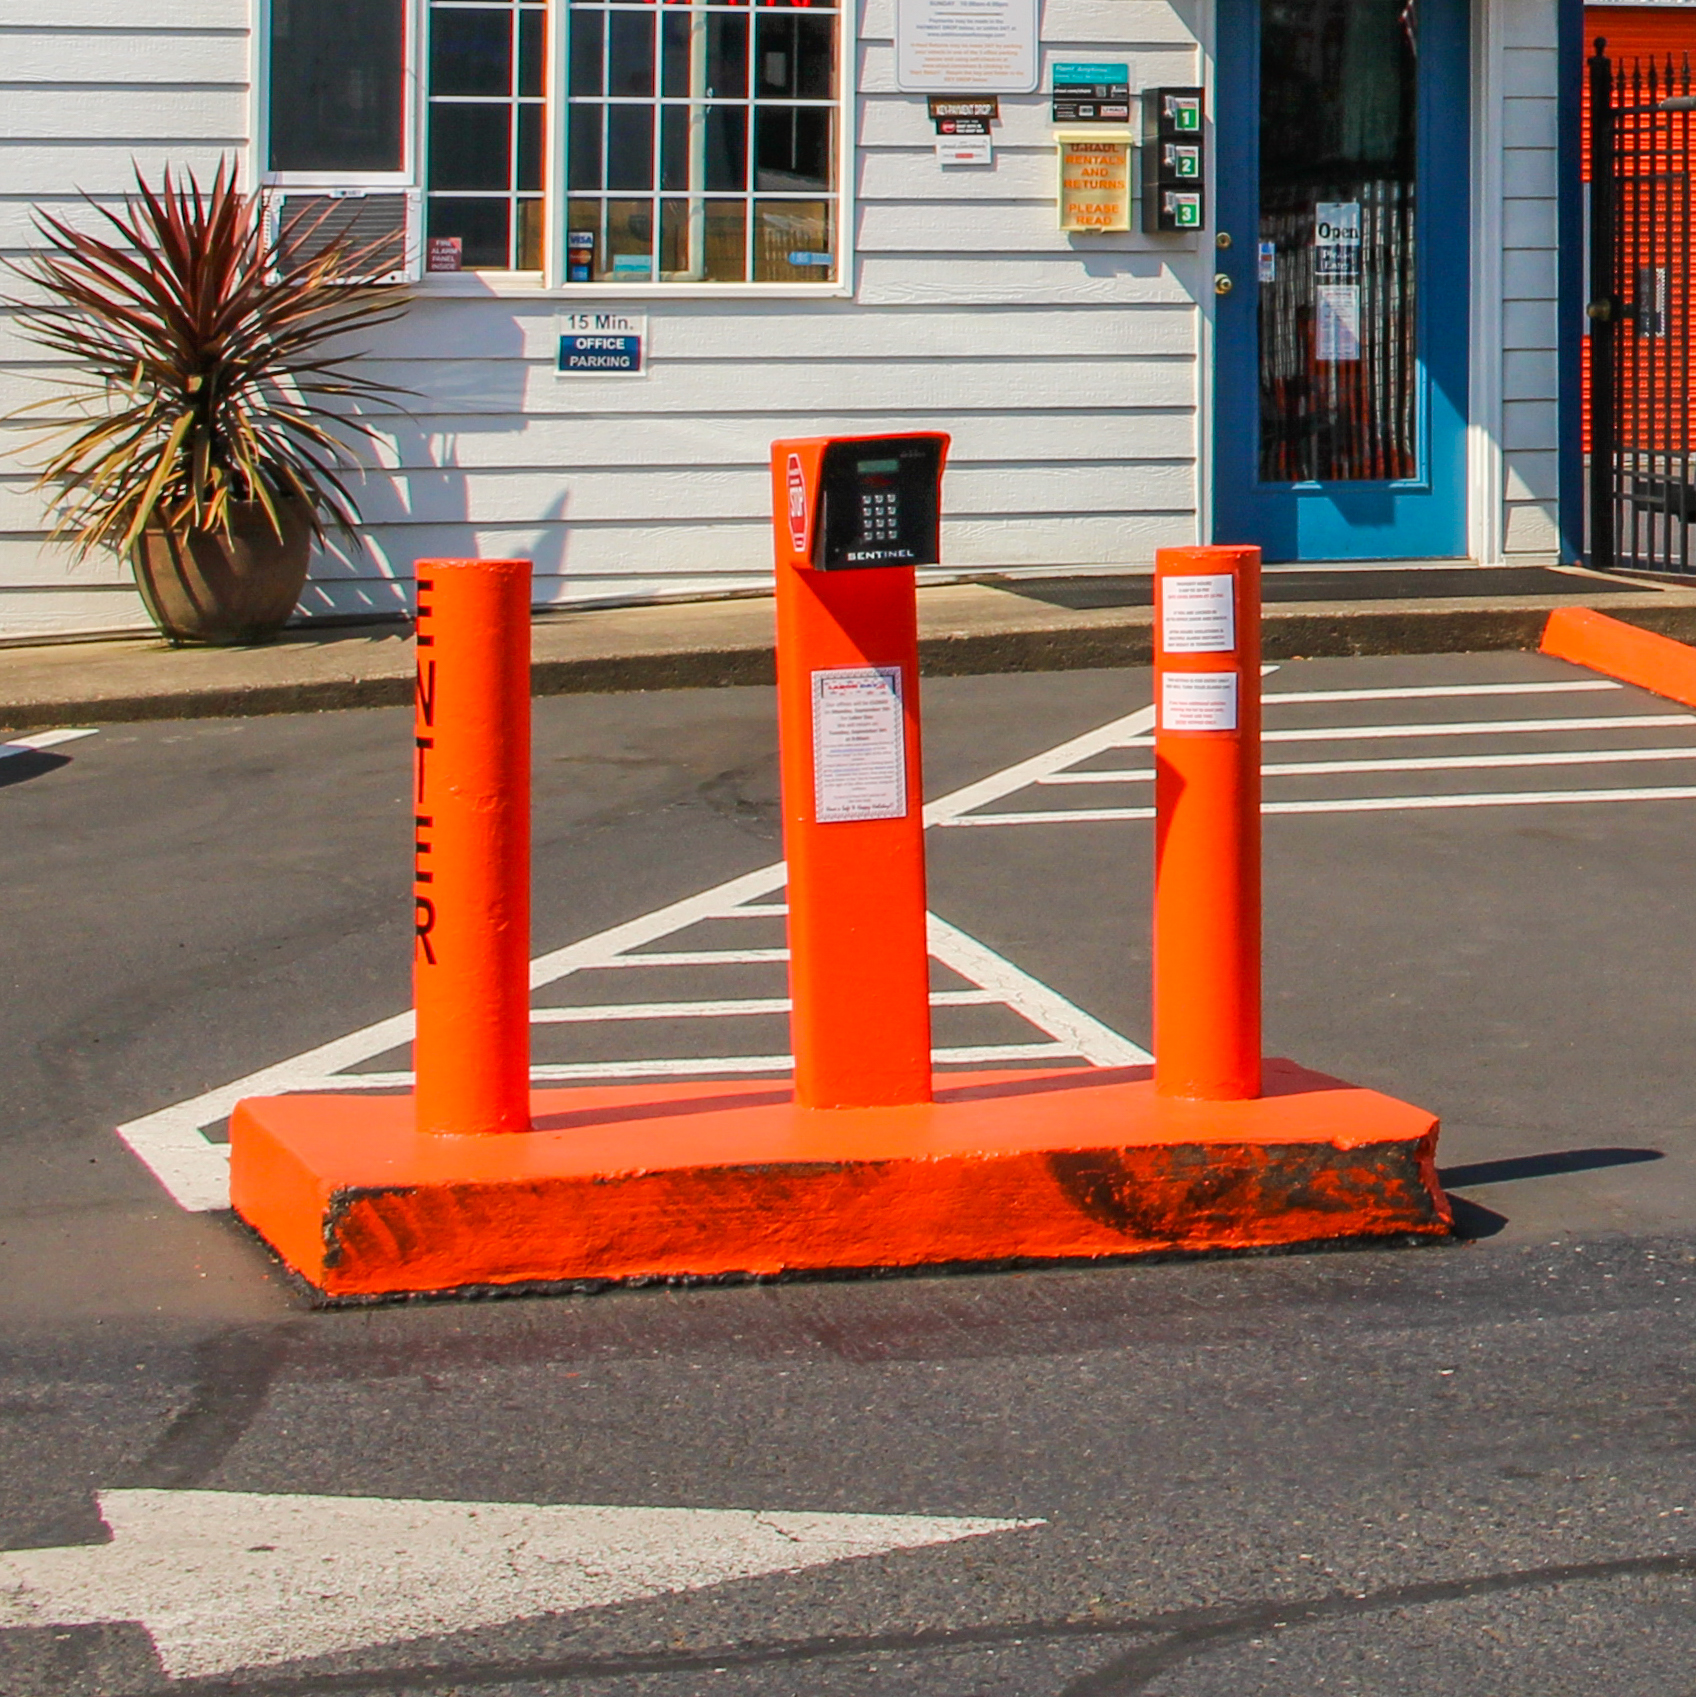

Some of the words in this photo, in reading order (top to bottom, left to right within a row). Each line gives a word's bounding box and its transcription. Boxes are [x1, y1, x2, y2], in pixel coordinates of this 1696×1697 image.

[1182, 111, 1190, 125] 1
[1070, 143, 1119, 153] U-HAUL
[1065, 155, 1125, 165] RENTALS
[1182, 158, 1191, 172] 2
[1081, 167, 1109, 177] AND
[1063, 179, 1125, 190] RETURNS
[1068, 203, 1119, 214] PLEASE
[1182, 206, 1192, 222] 3
[1076, 215, 1112, 225] READ
[1318, 221, 1359, 241] Open
[569, 235, 593, 245] VISA
[567, 314, 589, 330] 15
[595, 314, 634, 330] Min.
[576, 337, 625, 350] OFFICE
[569, 355, 630, 368] PARKING
[789, 486, 804, 518] STOP
[847, 549, 916, 562] SENTINEL
[416, 579, 437, 965] ENTER
